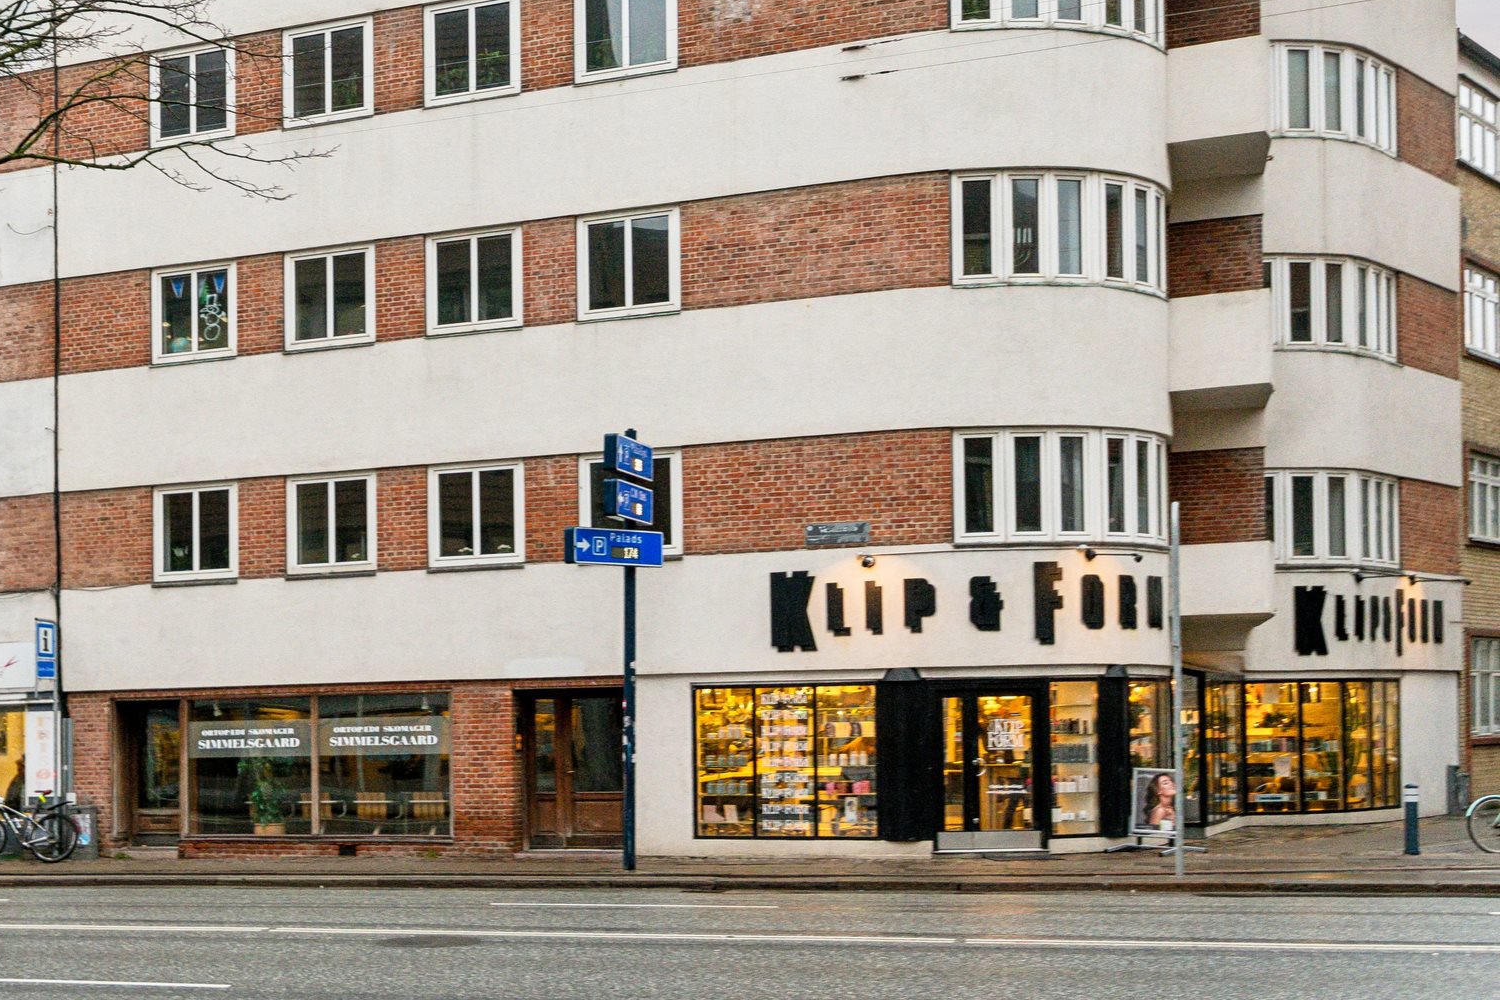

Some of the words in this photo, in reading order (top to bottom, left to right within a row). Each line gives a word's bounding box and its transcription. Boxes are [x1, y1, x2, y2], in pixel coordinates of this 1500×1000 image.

[610, 532, 642, 544] Palads
[623, 547, 639, 559] 174
[770, 571, 936, 652] KLIP
[970, 576, 1004, 631] &
[197, 737, 300, 750] SIMMELSGAARD
[329, 734, 438, 747] SIMMELSGAARD
[987, 732, 1025, 747] FORM
